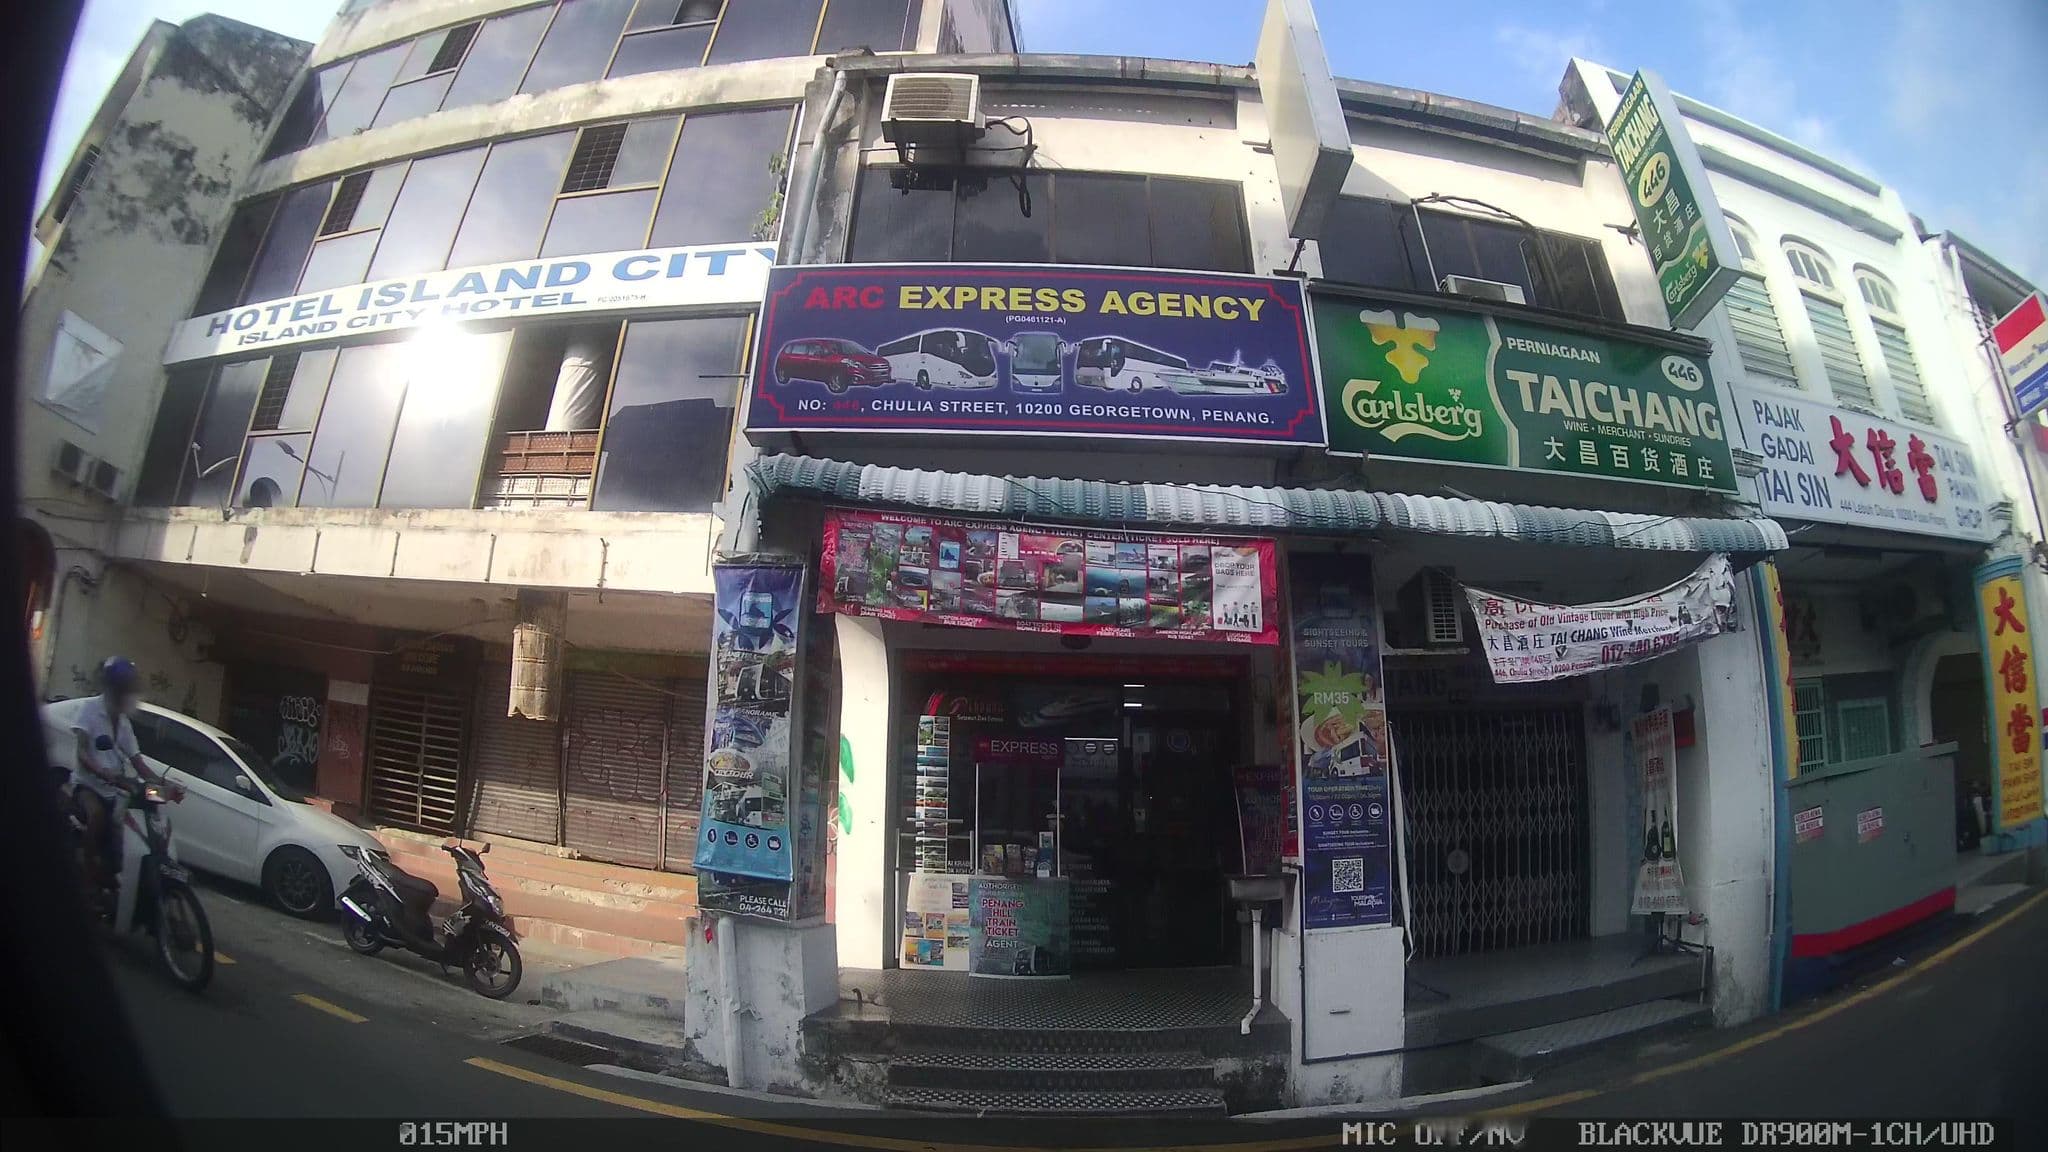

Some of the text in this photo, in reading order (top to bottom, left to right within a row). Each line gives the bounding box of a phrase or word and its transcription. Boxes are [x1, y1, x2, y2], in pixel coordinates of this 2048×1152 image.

[1614, 94, 1659, 173] TAICHANG
[1643, 160, 1665, 200] 446
[1652, 188, 1680, 234] 大昌
[1665, 264, 1698, 303] Carlsberg
[207, 296, 343, 338] HOTEL
[356, 262, 591, 311] ISLAND
[804, 285, 1266, 322] ARC EXPRESS AGENCY
[237, 320, 338, 346] ISLAND
[346, 306, 429, 329] CITY
[441, 292, 588, 315] HOTEL
[1507, 336, 1601, 365] PERNIAGAAN
[1668, 363, 1699, 384] 446
[798, 399, 827, 412] NO:
[871, 399, 934, 412] CHULIA
[940, 400, 1009, 415] STREET,
[1015, 402, 1063, 416] 10200
[1069, 403, 1196, 422] GEORGETOWN,
[1202, 409, 1275, 425] PENANG.
[1341, 378, 1484, 441] Carlsberg
[1506, 369, 1723, 441] TAICHANG
[1752, 399, 1805, 432] PAJAK
[1563, 420, 1692, 448] WINE MERCHANT SUNDRIES
[1544, 437, 1715, 481] 大昌百货酒庄
[1761, 432, 1815, 465] GADAI
[1761, 467, 1833, 508] TAI SIN
[881, 514, 927, 525] WELCOME
[930, 518, 942, 526] TO
[944, 520, 963, 528] ARC
[965, 521, 1007, 531] EXPRESS
[1050, 529, 1083, 537] TICKET
[1087, 531, 1124, 541] CENTER
[1528, 618, 1537, 629] of
[1540, 615, 1555, 626] Old
[1557, 612, 1589, 624] Vintage
[1634, 607, 1650, 620] High
[1304, 639, 1369, 648] SUNSET TOURS
[1488, 633, 1545, 652] 大昌酒庄
[1550, 631, 1568, 646] TAI
[1571, 626, 1609, 643] CHANG
[1611, 625, 1633, 638] Wine
[1993, 586, 2034, 754] 大信當
[1313, 691, 1350, 705] RM35
[991, 739, 1059, 754] EXPRESS
[740, 895, 787, 907] PLEASE CALL
[982, 898, 1025, 909] PENANG
[992, 908, 1012, 918] HILL
[986, 917, 1017, 927] TRAIN
[986, 926, 1020, 937] TICKET
[986, 940, 1019, 949] AGENT
